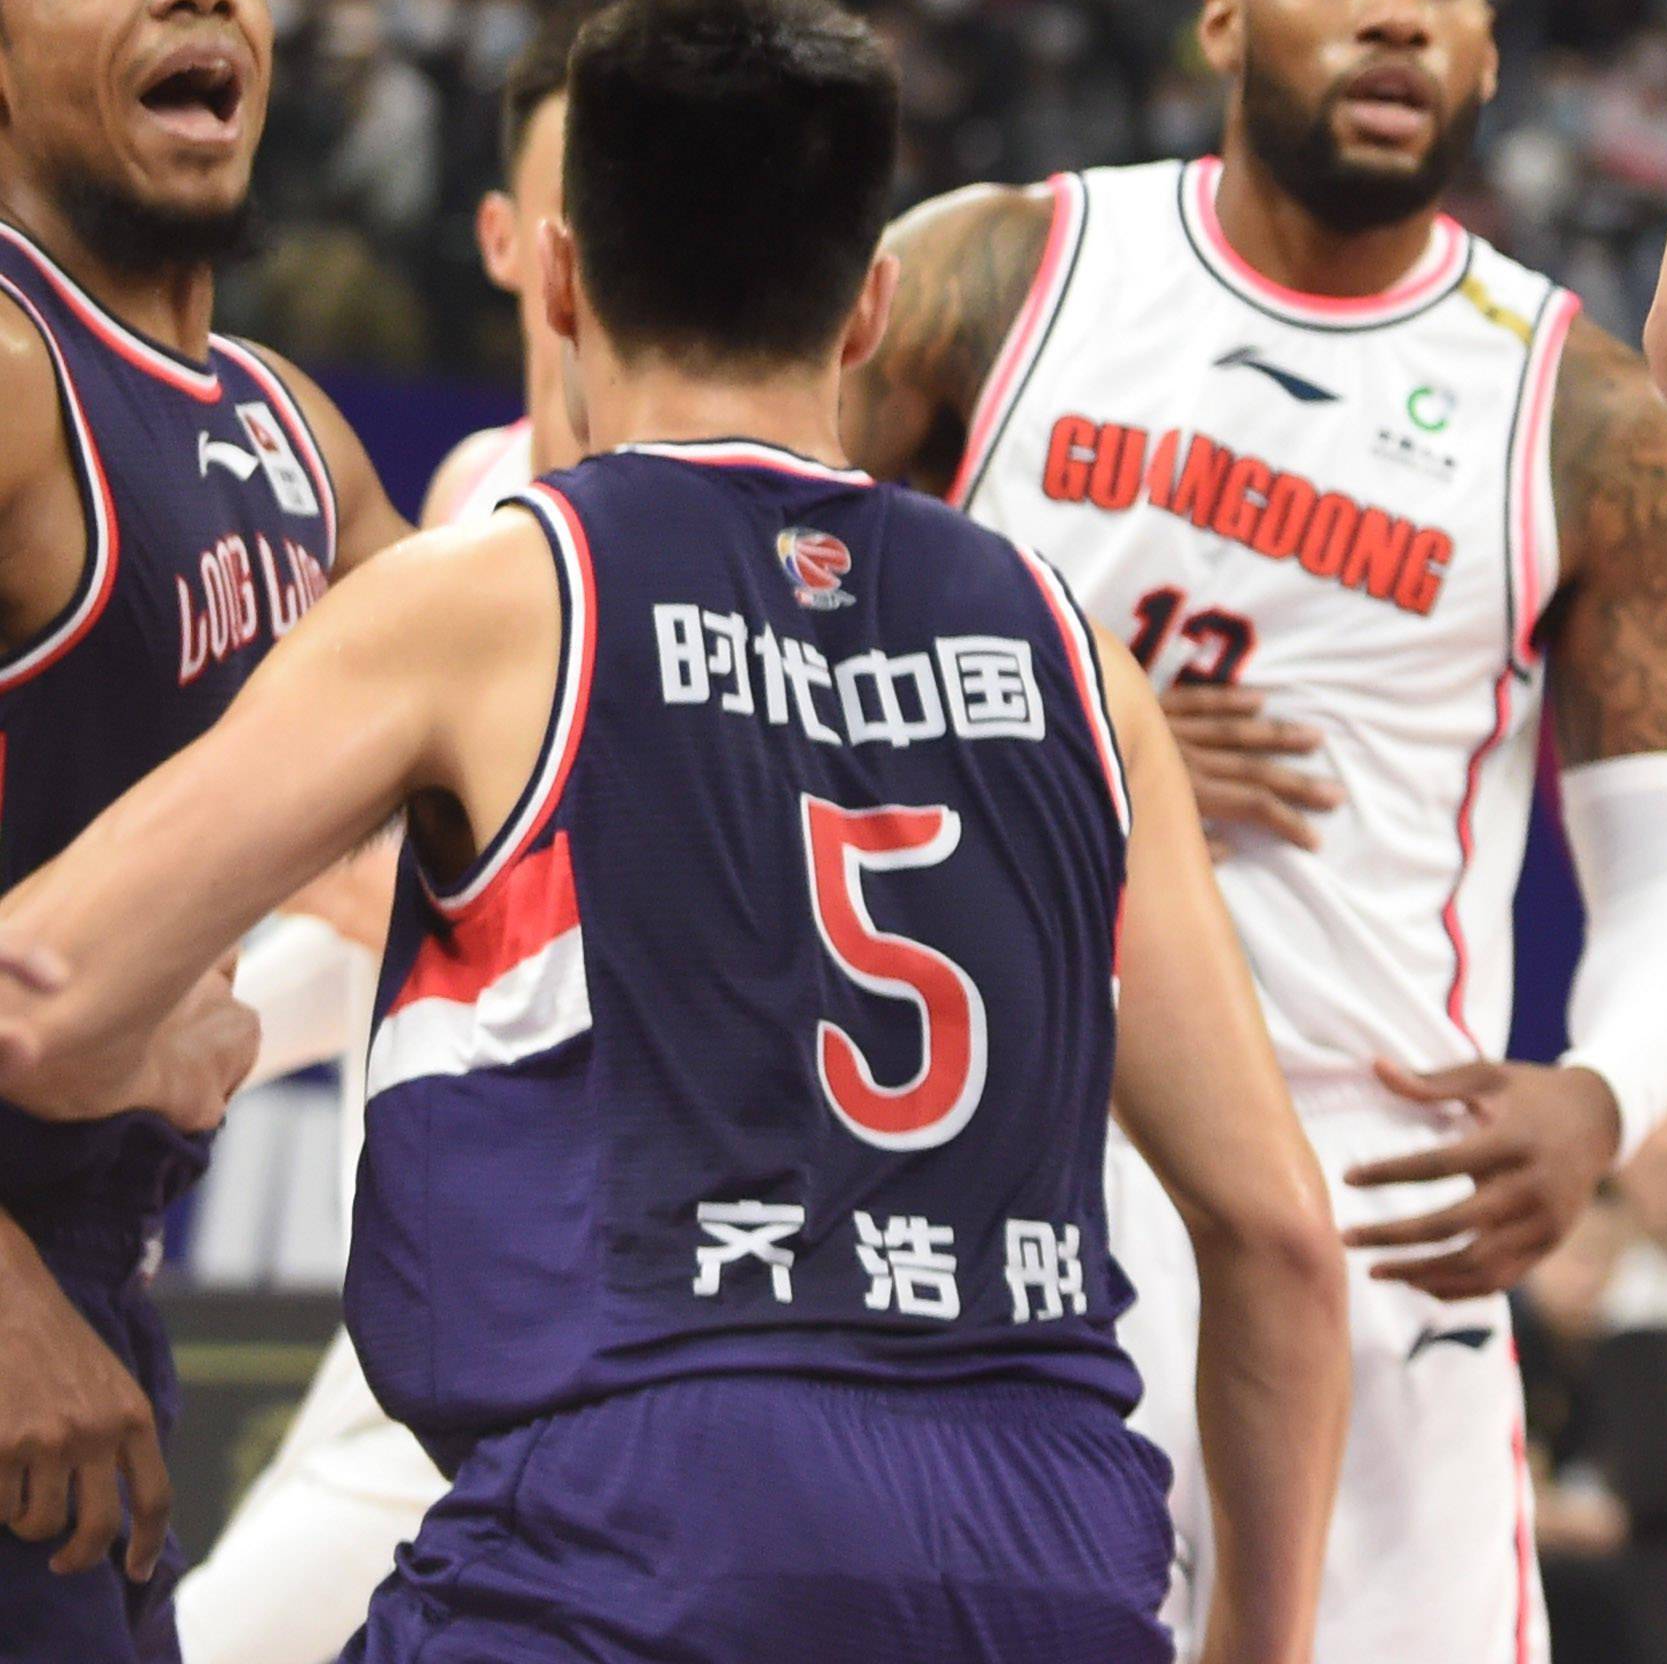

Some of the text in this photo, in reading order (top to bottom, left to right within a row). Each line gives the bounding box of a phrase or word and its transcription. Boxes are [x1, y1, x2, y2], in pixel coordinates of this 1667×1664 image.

[652, 603, 1047, 748] 时代中国
[801, 792, 988, 1151] 5
